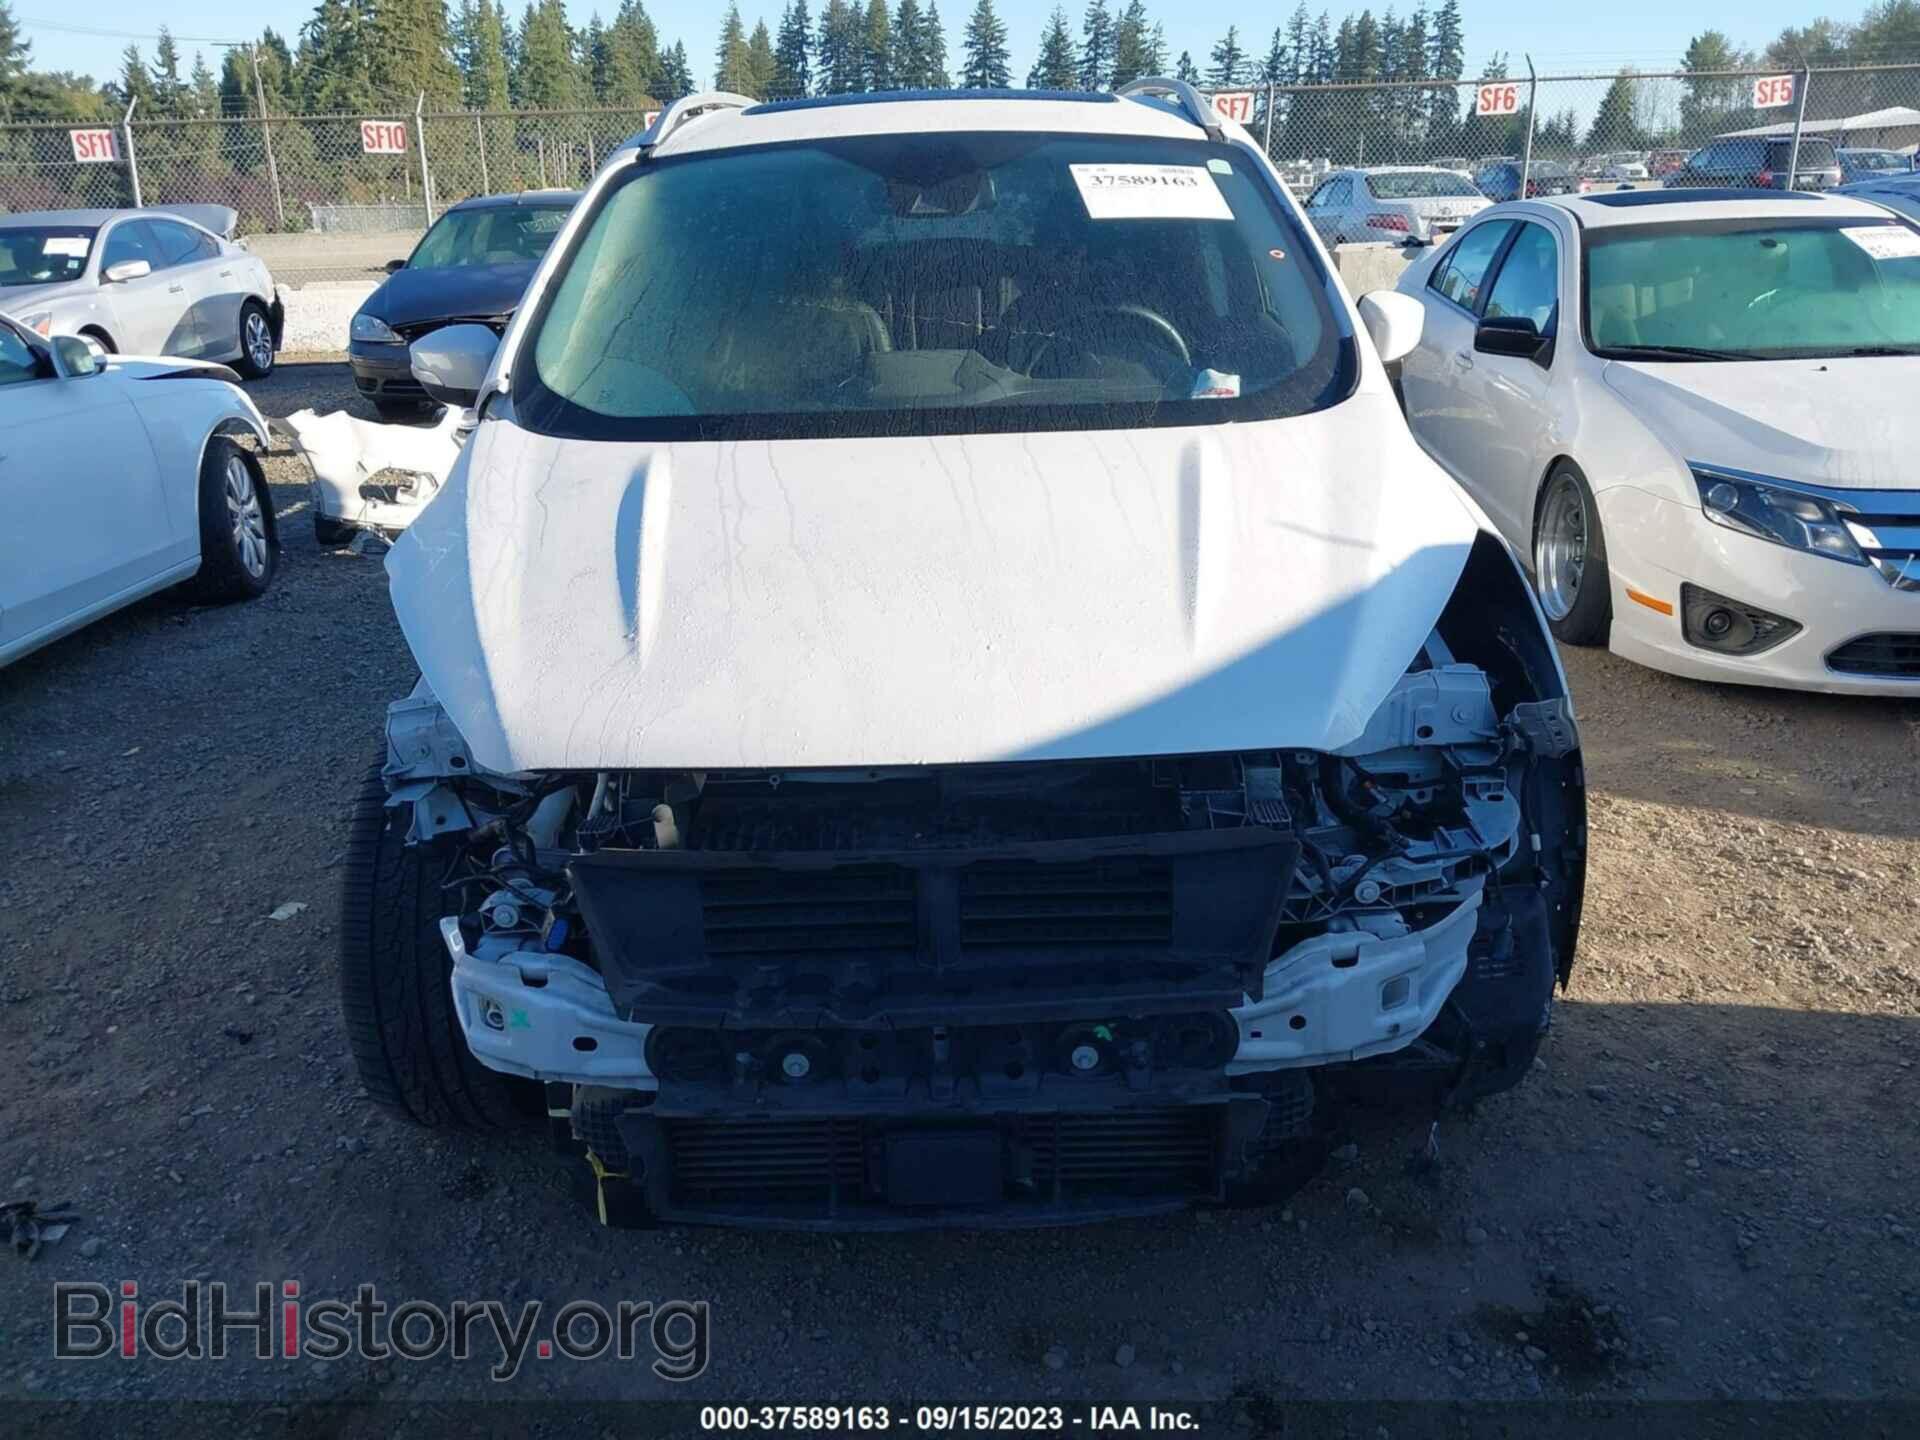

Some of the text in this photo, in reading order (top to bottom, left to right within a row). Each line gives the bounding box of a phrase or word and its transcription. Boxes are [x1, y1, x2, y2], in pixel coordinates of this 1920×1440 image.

[1480, 86, 1516, 112] SF6
[1757, 79, 1793, 105] SF5
[1216, 95, 1250, 121] SF7
[76, 132, 116, 158] SF11
[363, 124, 406, 150] SF10
[1089, 174, 1199, 187] 37589163
